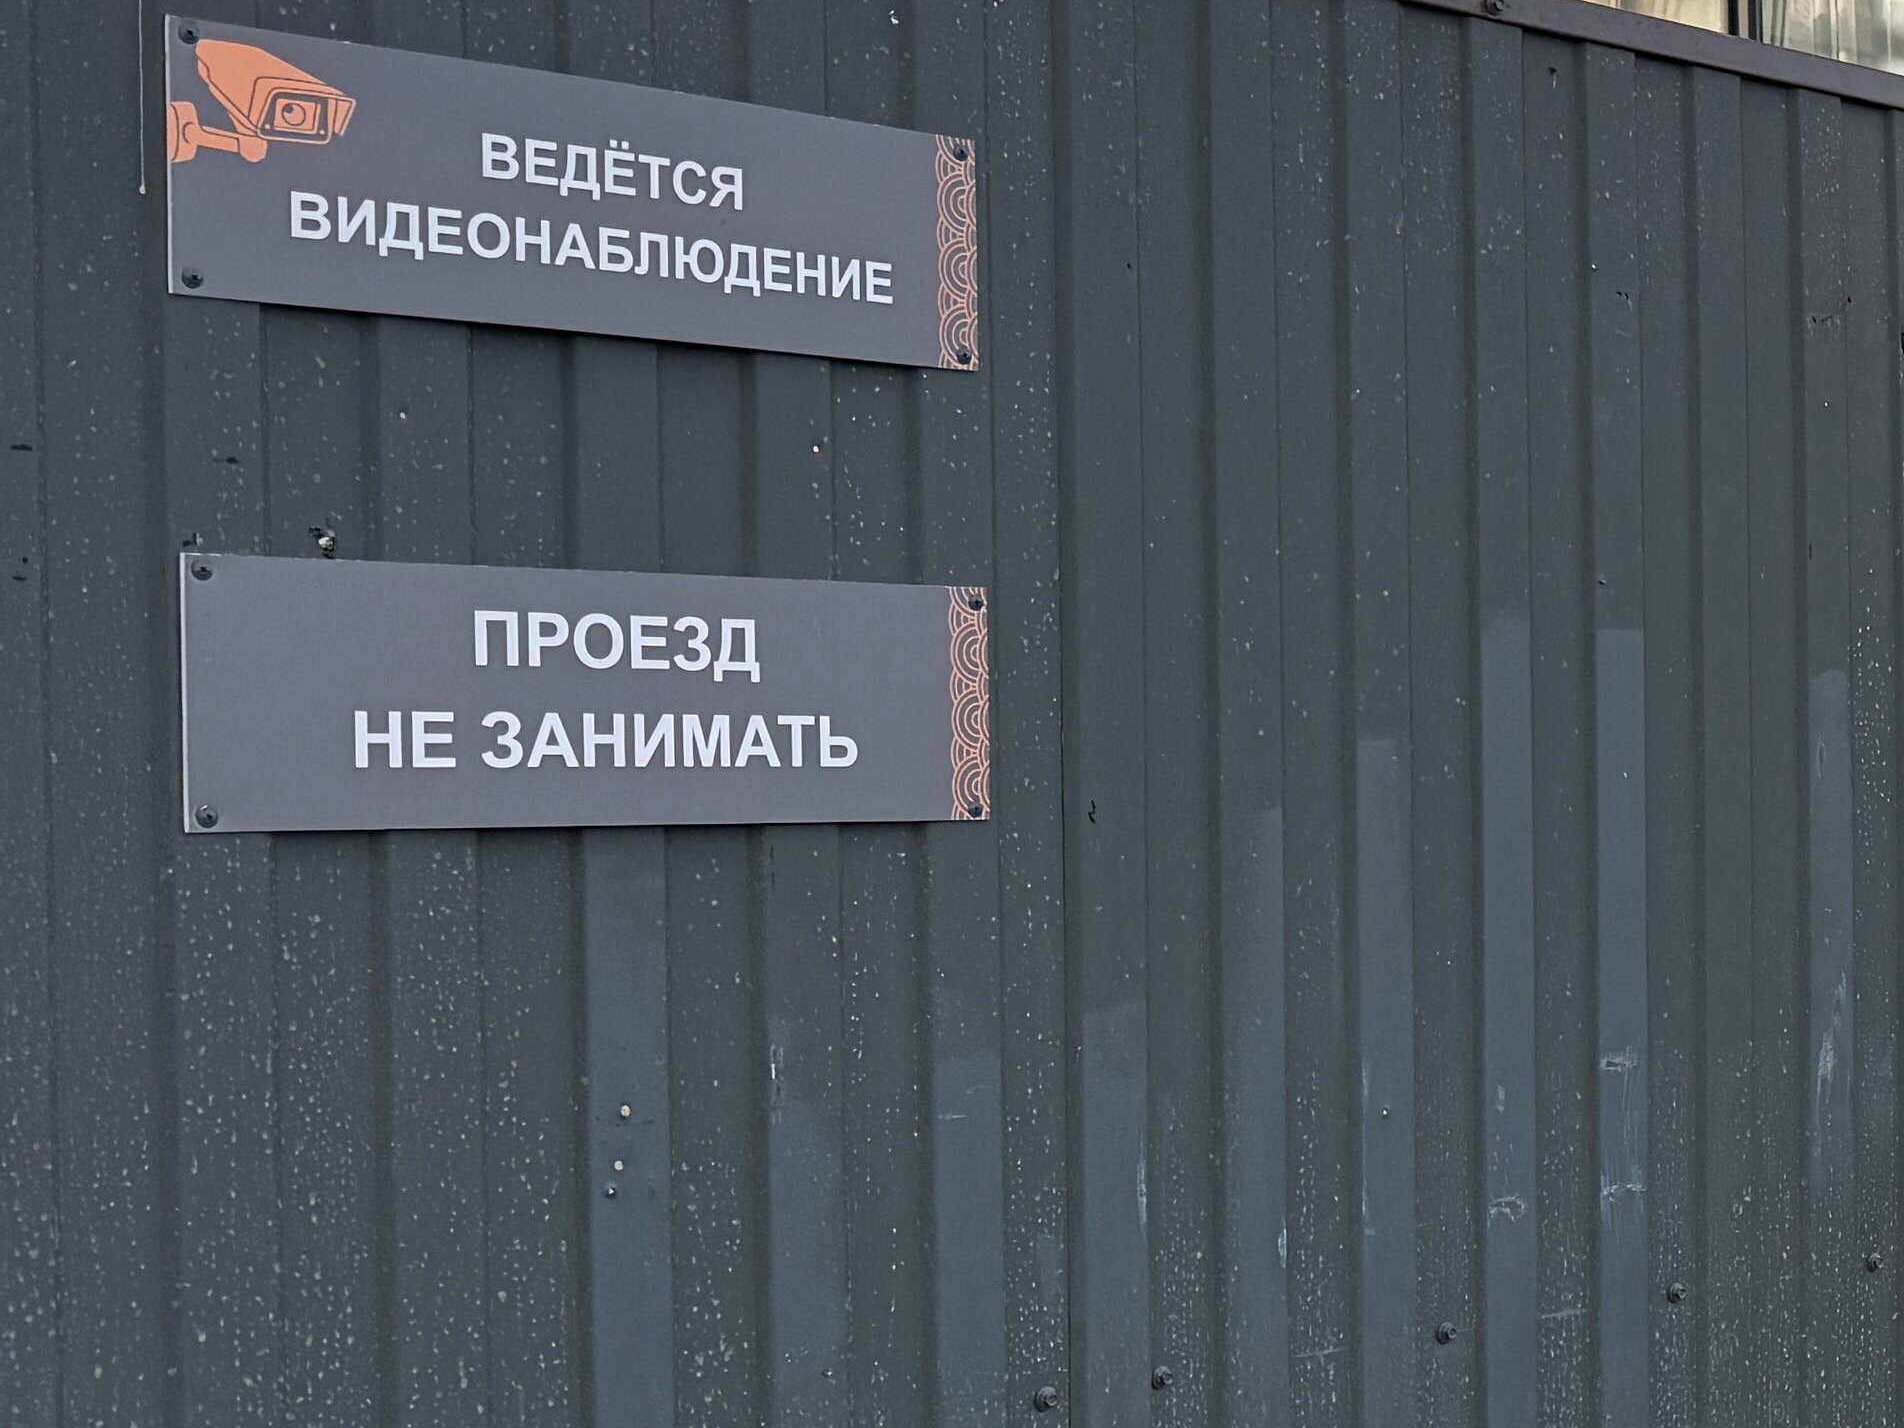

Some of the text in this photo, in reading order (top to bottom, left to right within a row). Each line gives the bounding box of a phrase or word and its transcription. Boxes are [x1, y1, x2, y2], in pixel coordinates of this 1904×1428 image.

[481, 131, 745, 211] ВЕДЁТСЯ
[289, 191, 895, 305] ВИДЕОНАБЛЮДЕНИЕ
[472, 609, 761, 683] ПРОЕЗД
[353, 709, 859, 770] НЕ ЗАНИМАТЬ
